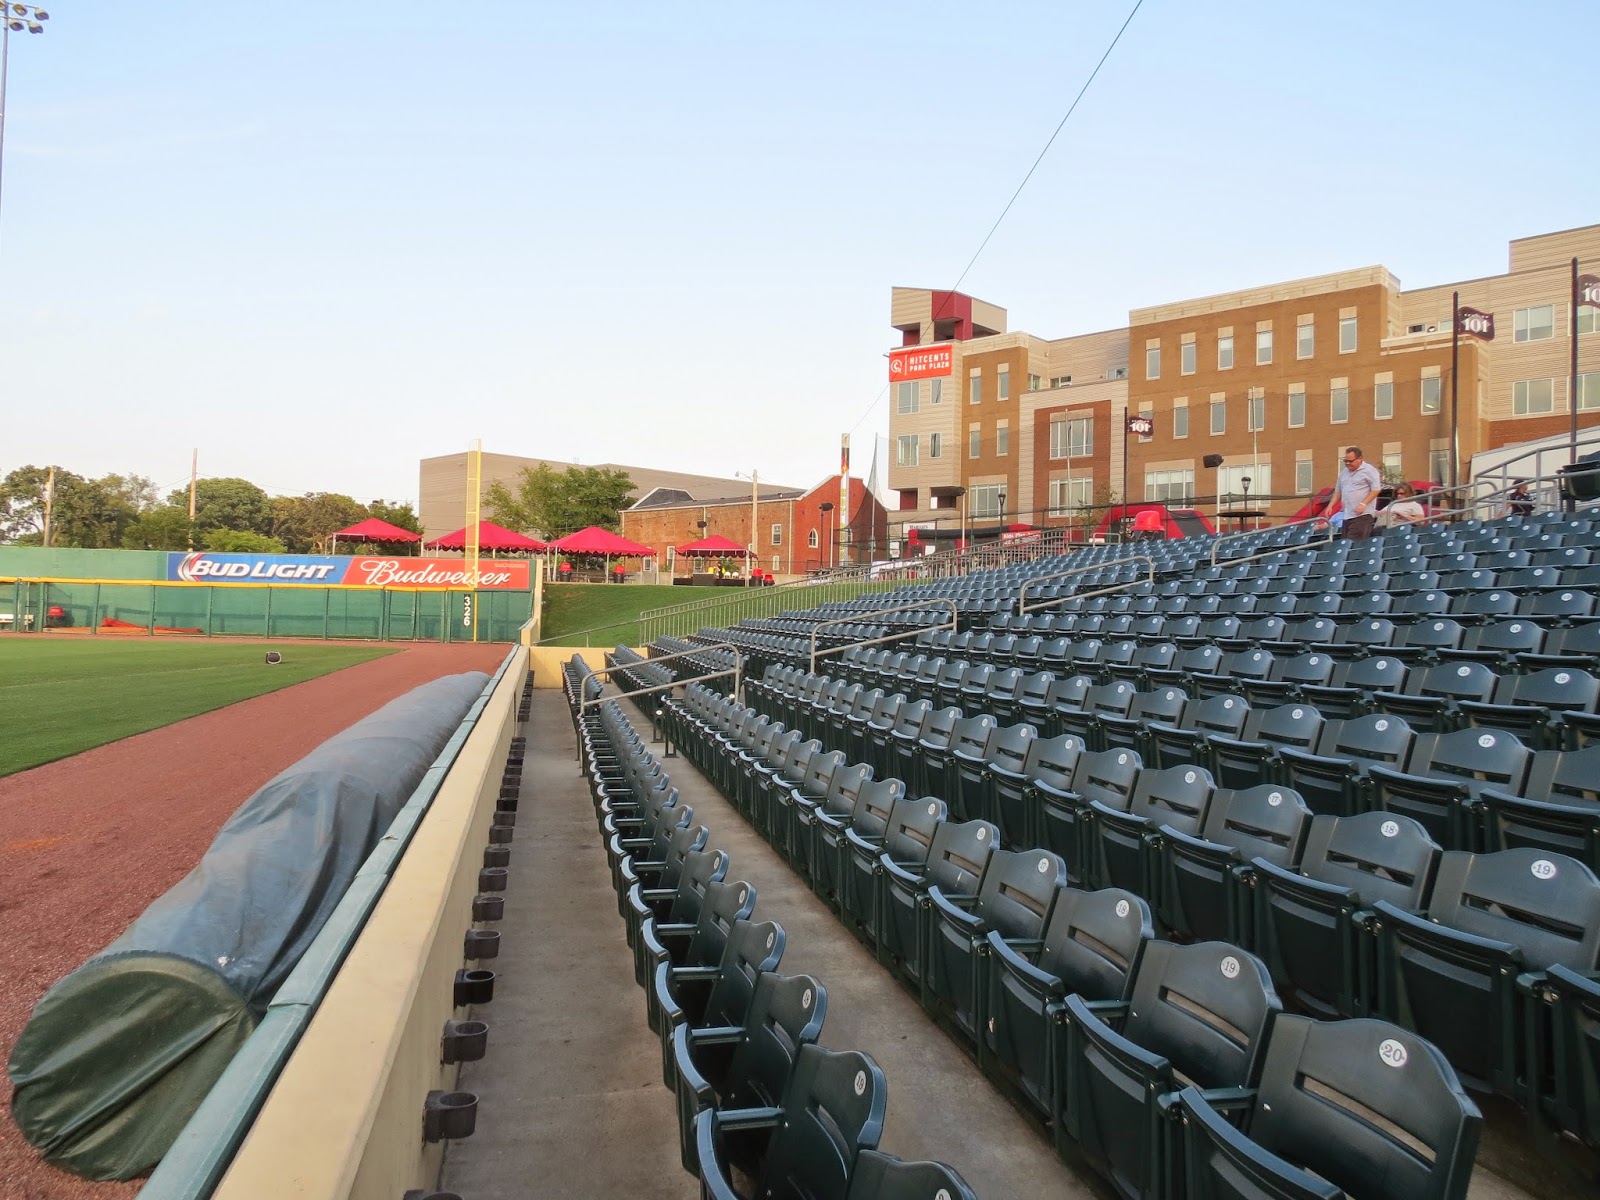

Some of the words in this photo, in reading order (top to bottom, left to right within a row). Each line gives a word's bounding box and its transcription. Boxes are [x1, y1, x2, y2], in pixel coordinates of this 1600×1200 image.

[1463, 317, 1489, 333] 101
[910, 353, 949, 364] HITCENTS
[929, 361, 949, 369] PLAZA
[1132, 422, 1149, 432] 101
[190, 560, 250, 577] BUD
[250, 562, 334, 579] LIGHT
[360, 560, 511, 585] Budweiser
[463, 597, 471, 626] 326
[1536, 864, 1551, 875] 19
[1224, 961, 1236, 973] 19
[1382, 1043, 1403, 1063] 20
